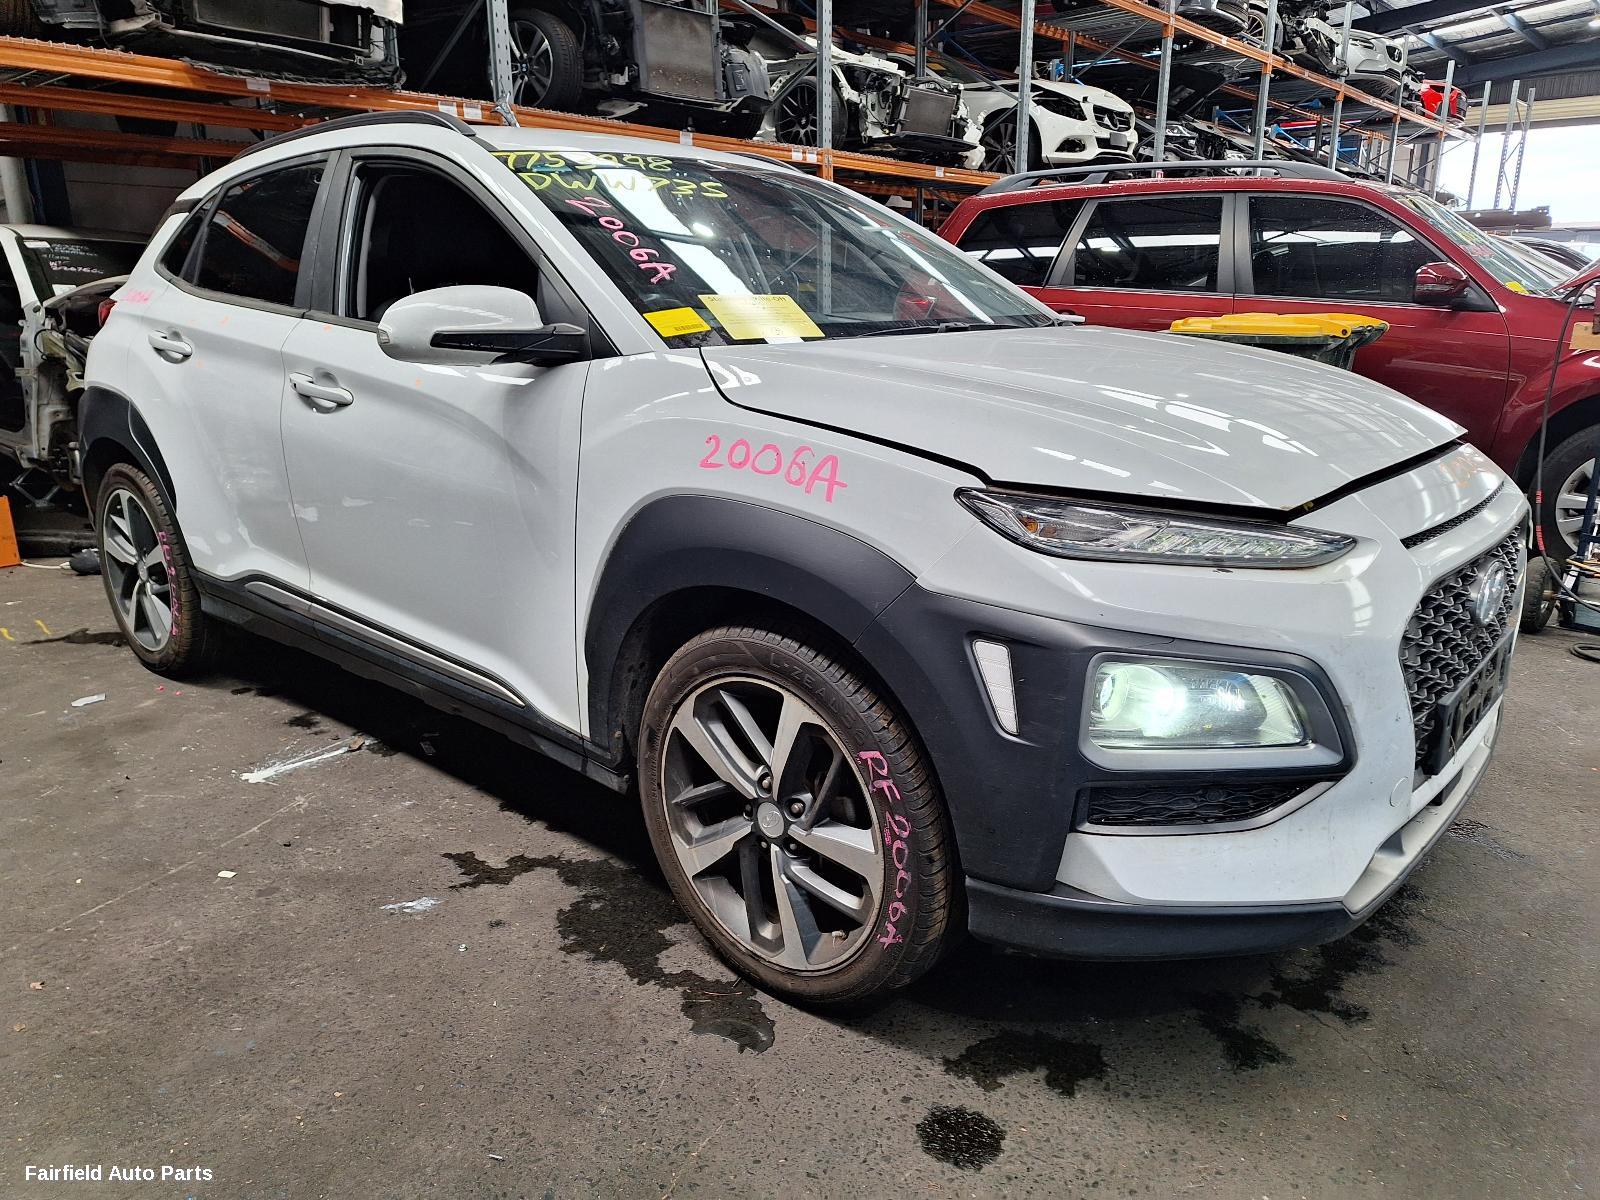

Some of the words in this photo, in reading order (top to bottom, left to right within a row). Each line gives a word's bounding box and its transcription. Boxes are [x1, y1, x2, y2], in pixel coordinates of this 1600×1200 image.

[564, 196, 677, 285] 2006A
[699, 434, 848, 503] 2006A
[857, 750, 901, 803] RF
[876, 810, 913, 951] 2006A
